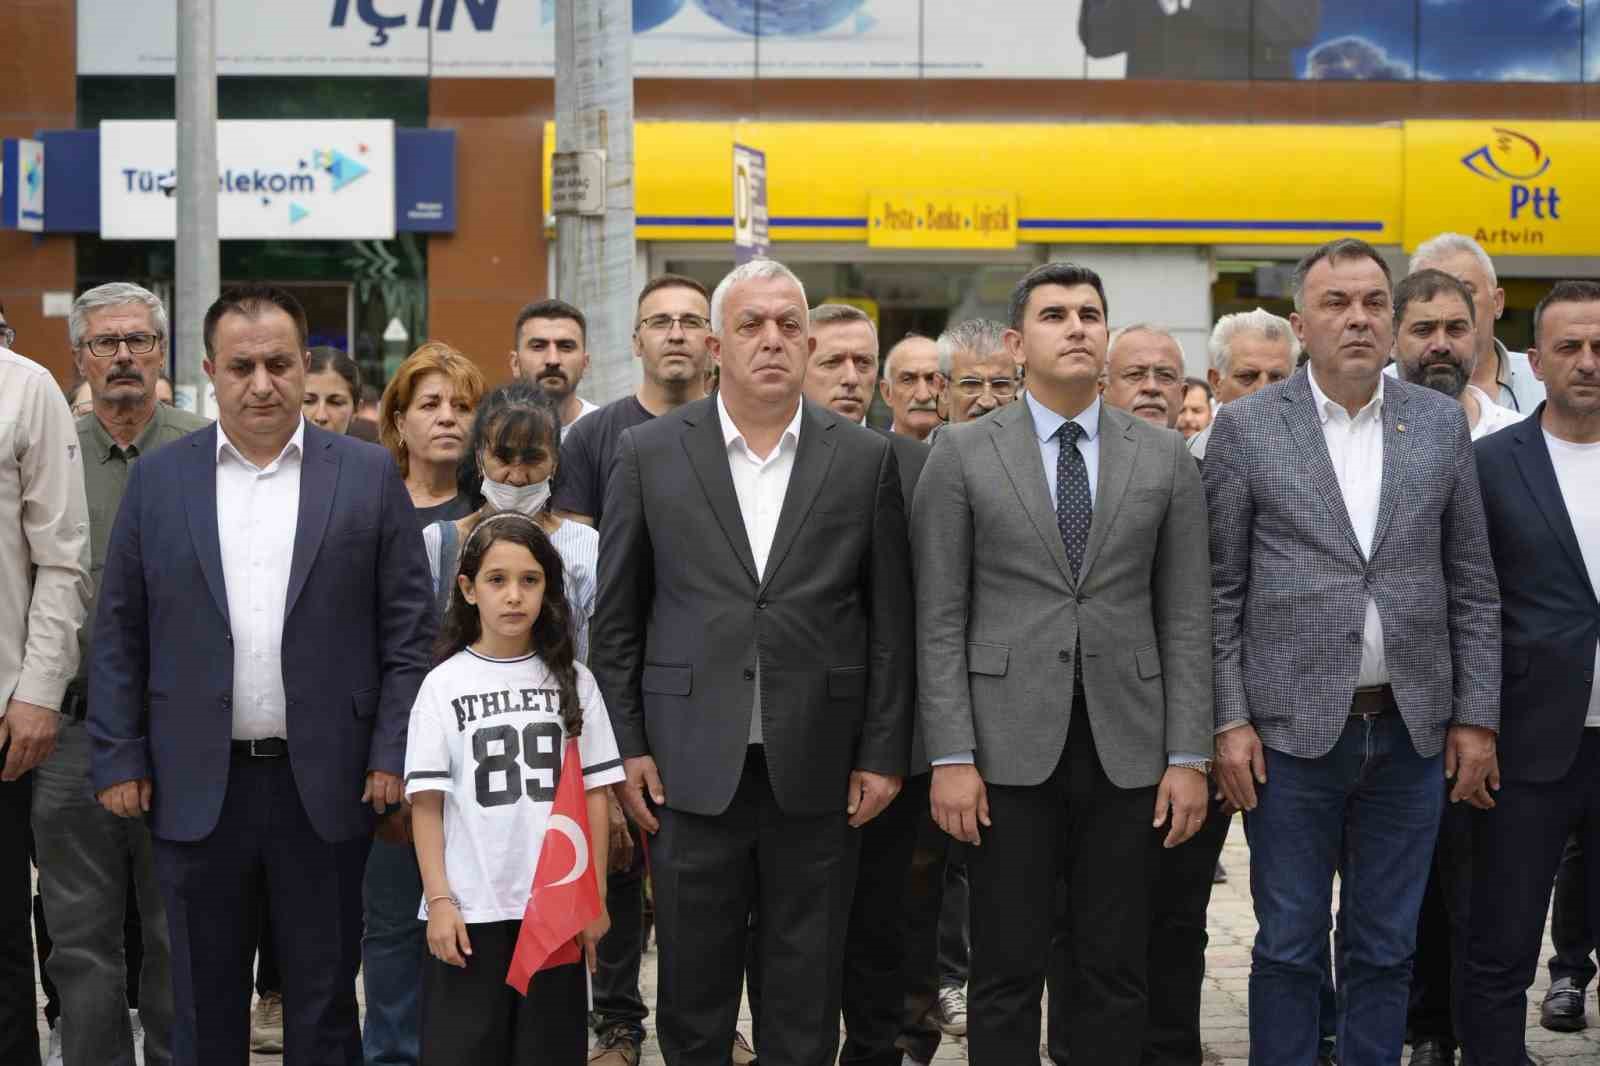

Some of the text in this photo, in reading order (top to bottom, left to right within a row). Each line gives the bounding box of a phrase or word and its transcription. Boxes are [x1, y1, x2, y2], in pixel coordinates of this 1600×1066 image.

[122, 168, 314, 193] Tür lekom
[1510, 184, 1560, 220] Ptt
[1474, 227, 1544, 244] Artvin
[451, 688, 563, 732] ATHLET
[472, 721, 563, 808] 89
